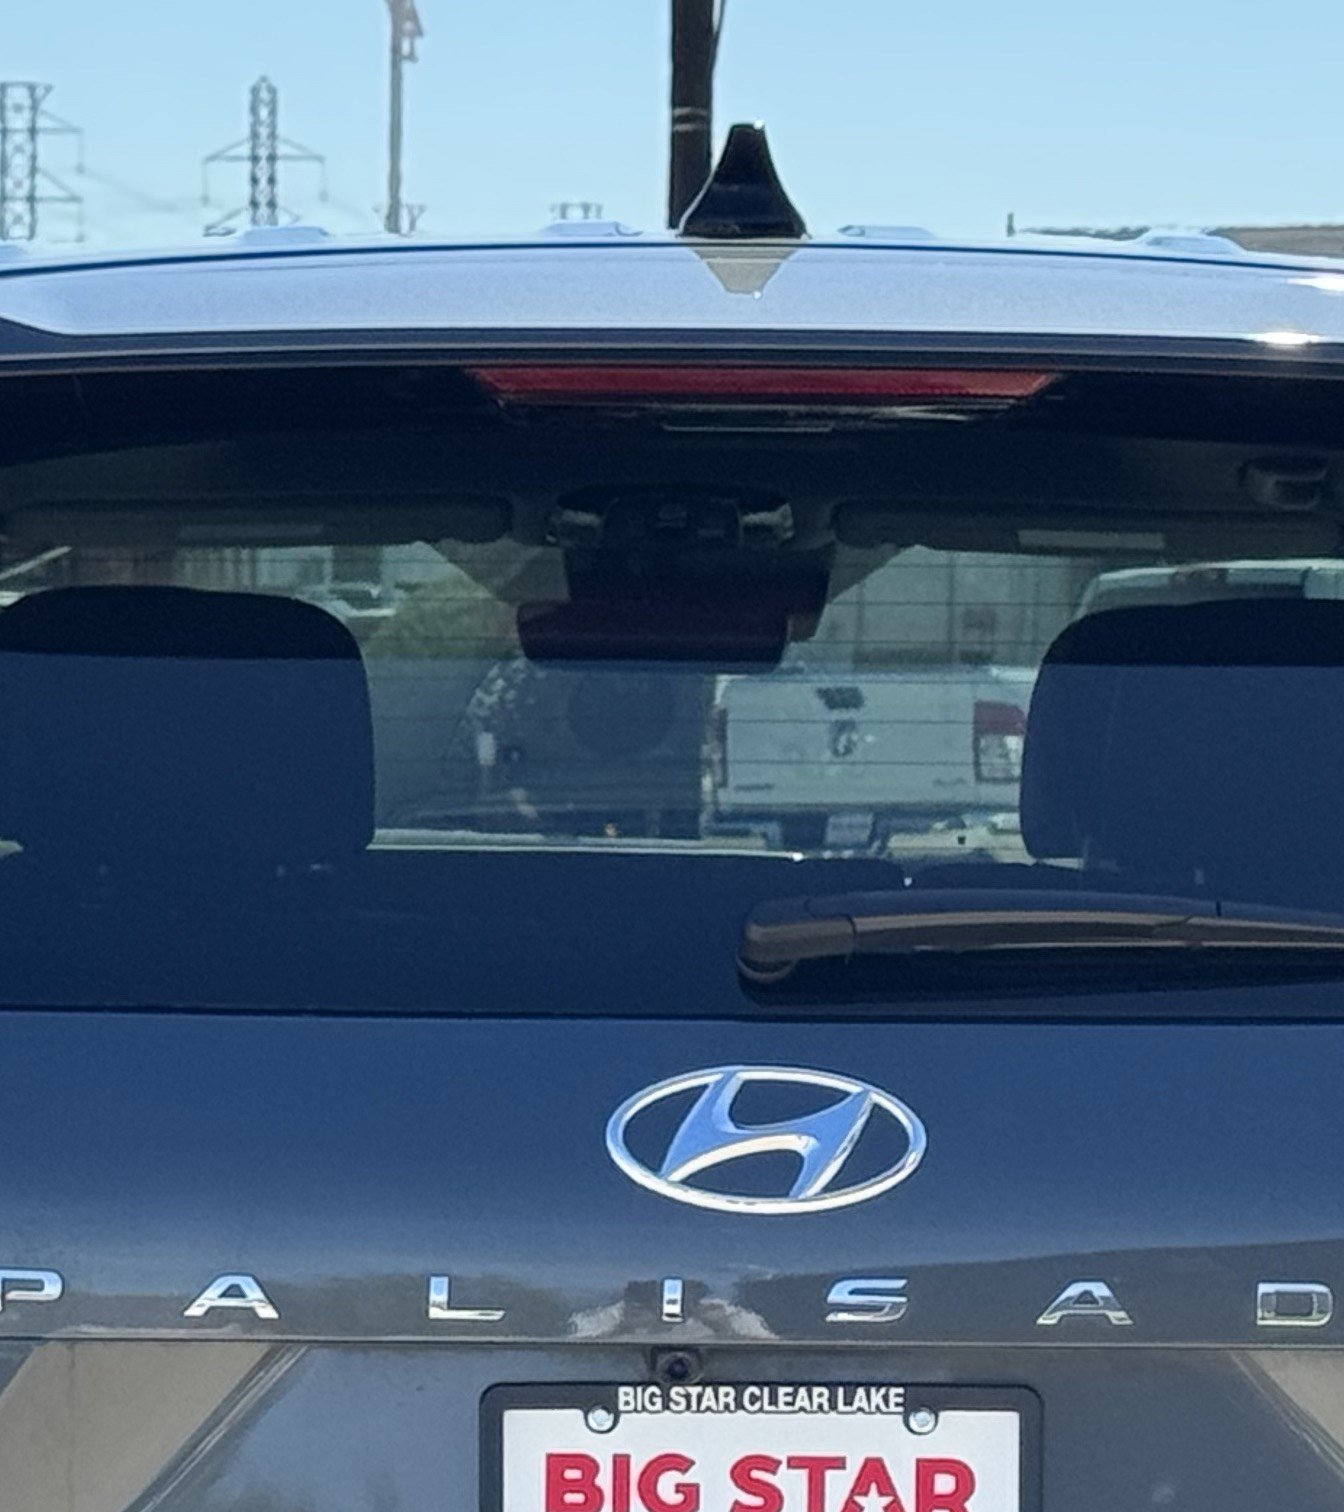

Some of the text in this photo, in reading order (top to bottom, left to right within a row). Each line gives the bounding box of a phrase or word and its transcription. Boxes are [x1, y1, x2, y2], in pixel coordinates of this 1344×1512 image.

[617, 1385, 905, 1413] BIG STAR CLEAR LAKE
